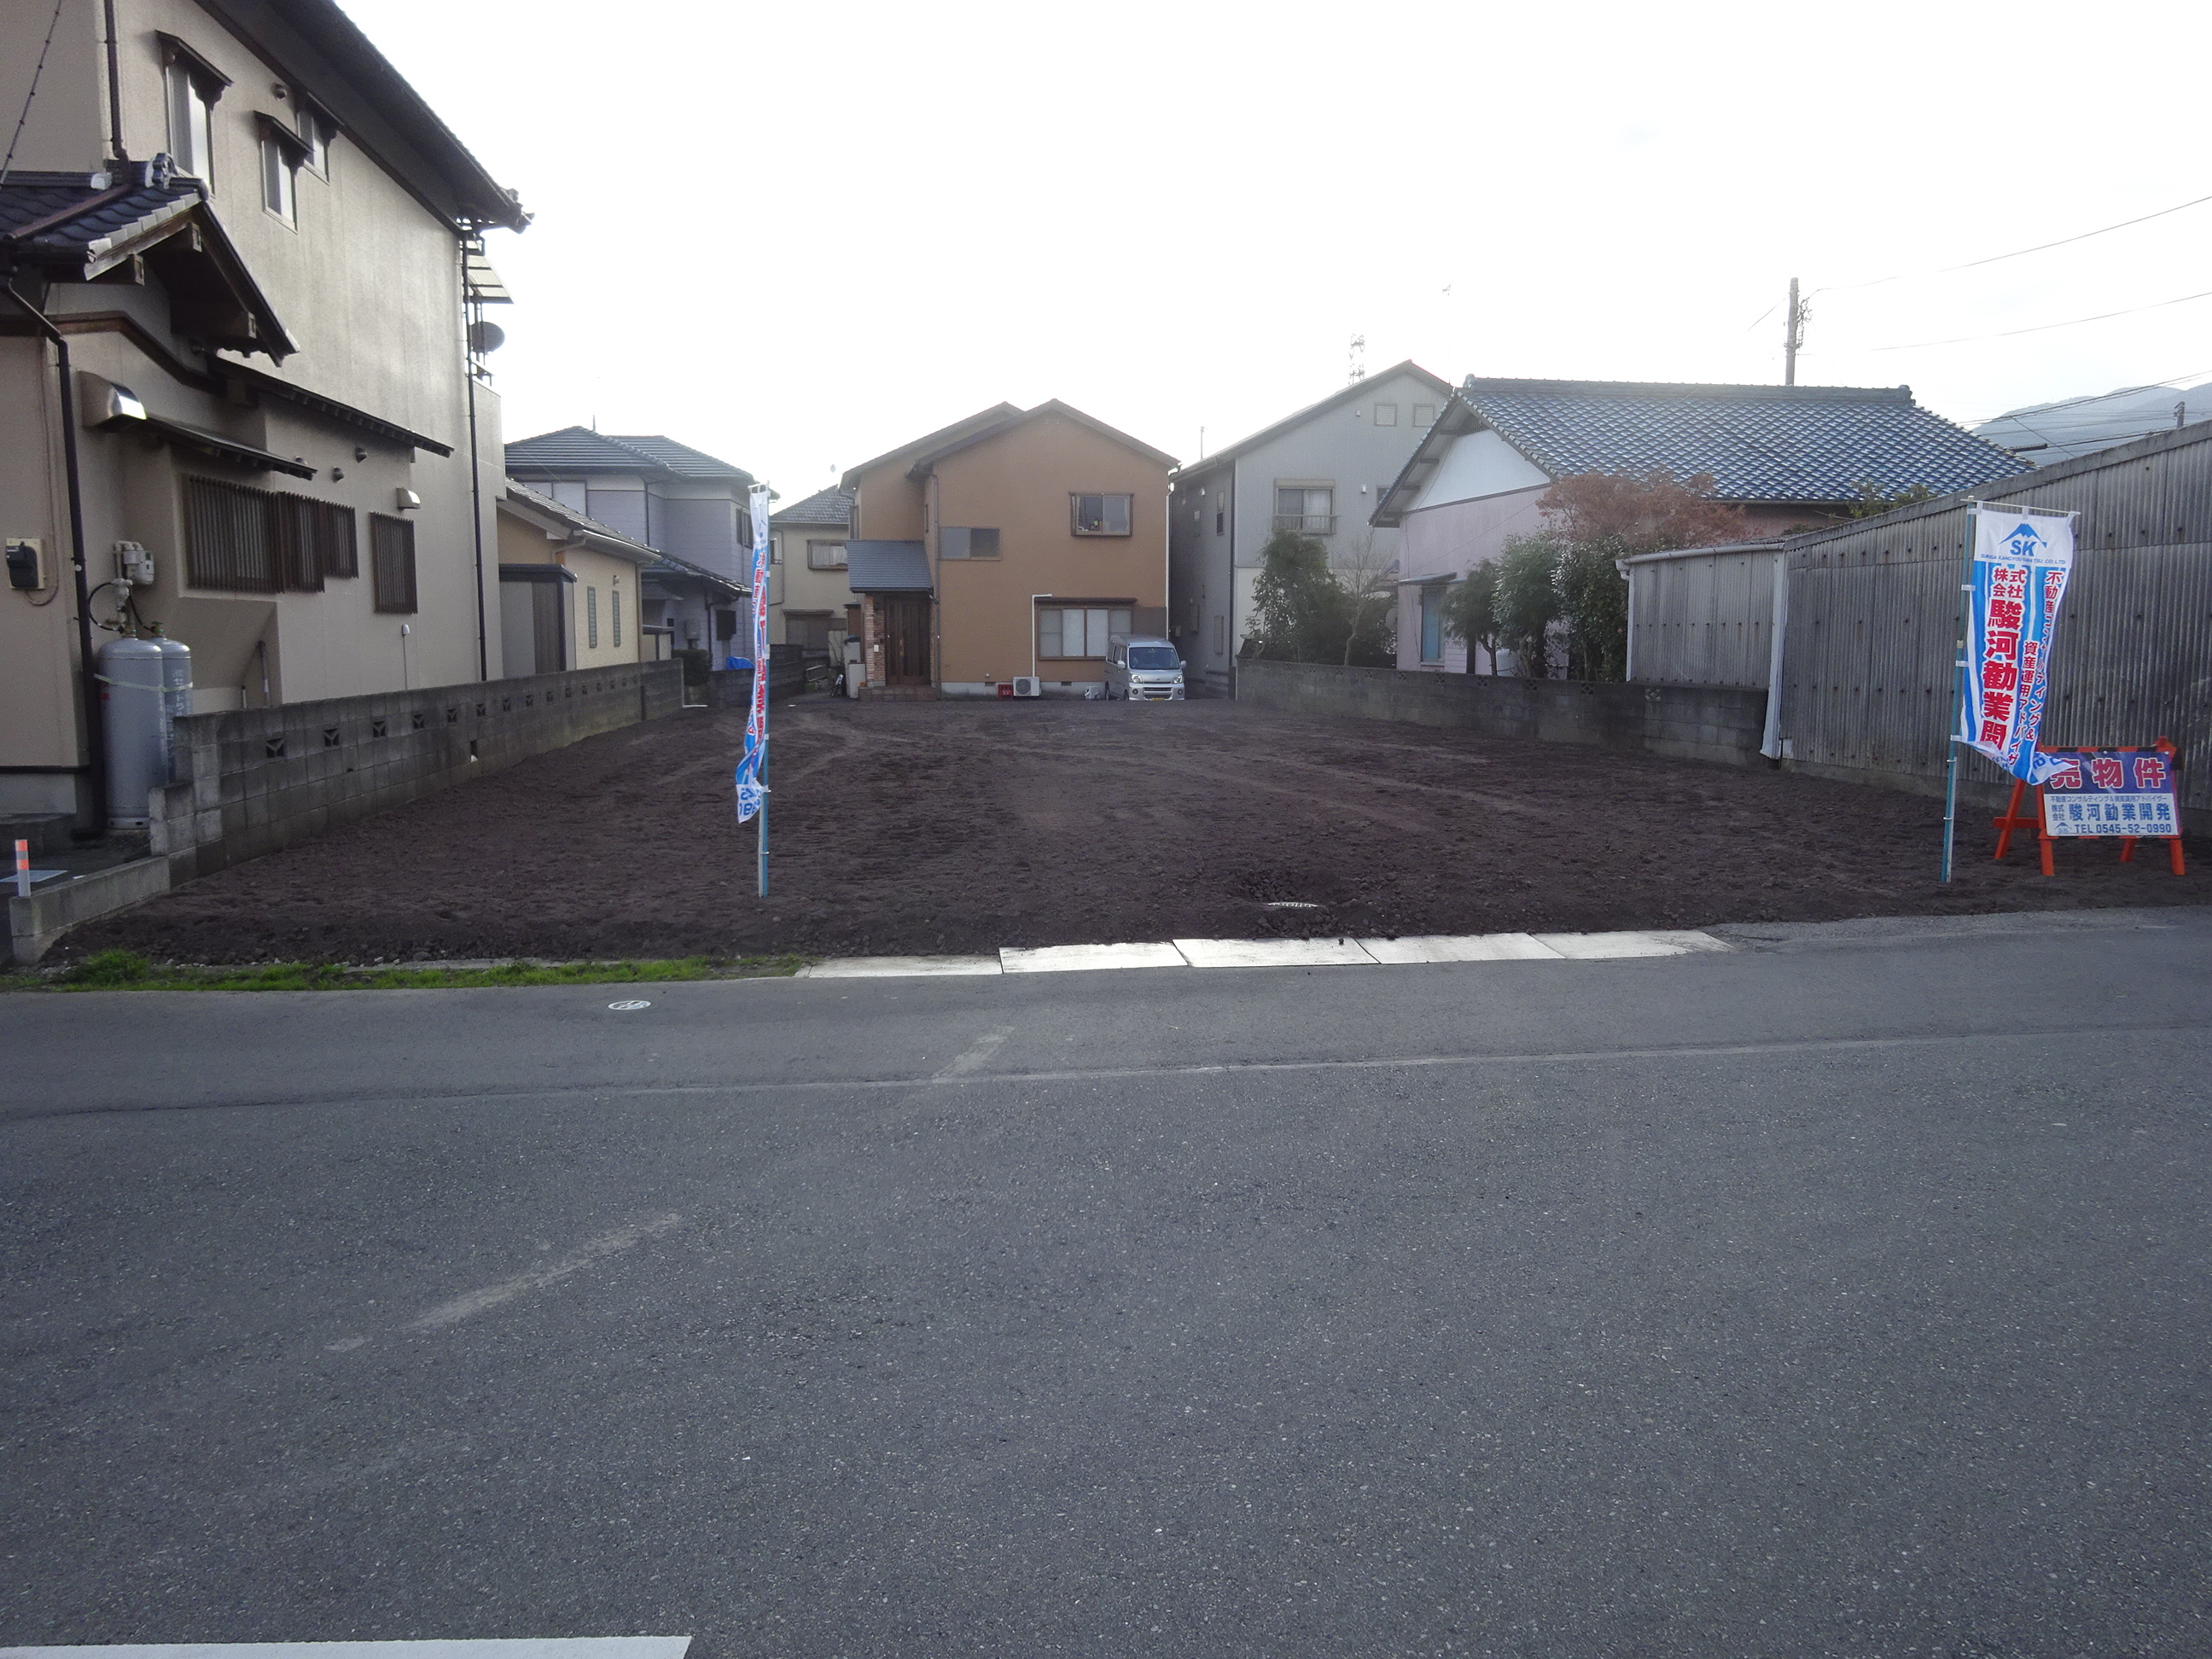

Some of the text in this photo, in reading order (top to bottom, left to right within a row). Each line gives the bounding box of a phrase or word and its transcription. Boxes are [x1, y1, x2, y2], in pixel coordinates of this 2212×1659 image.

[2010, 539, 2036, 556] SK
[2069, 803, 2171, 821] 駿河勧業開発
[2075, 824, 2172, 834] TEL 0545-52-0990
